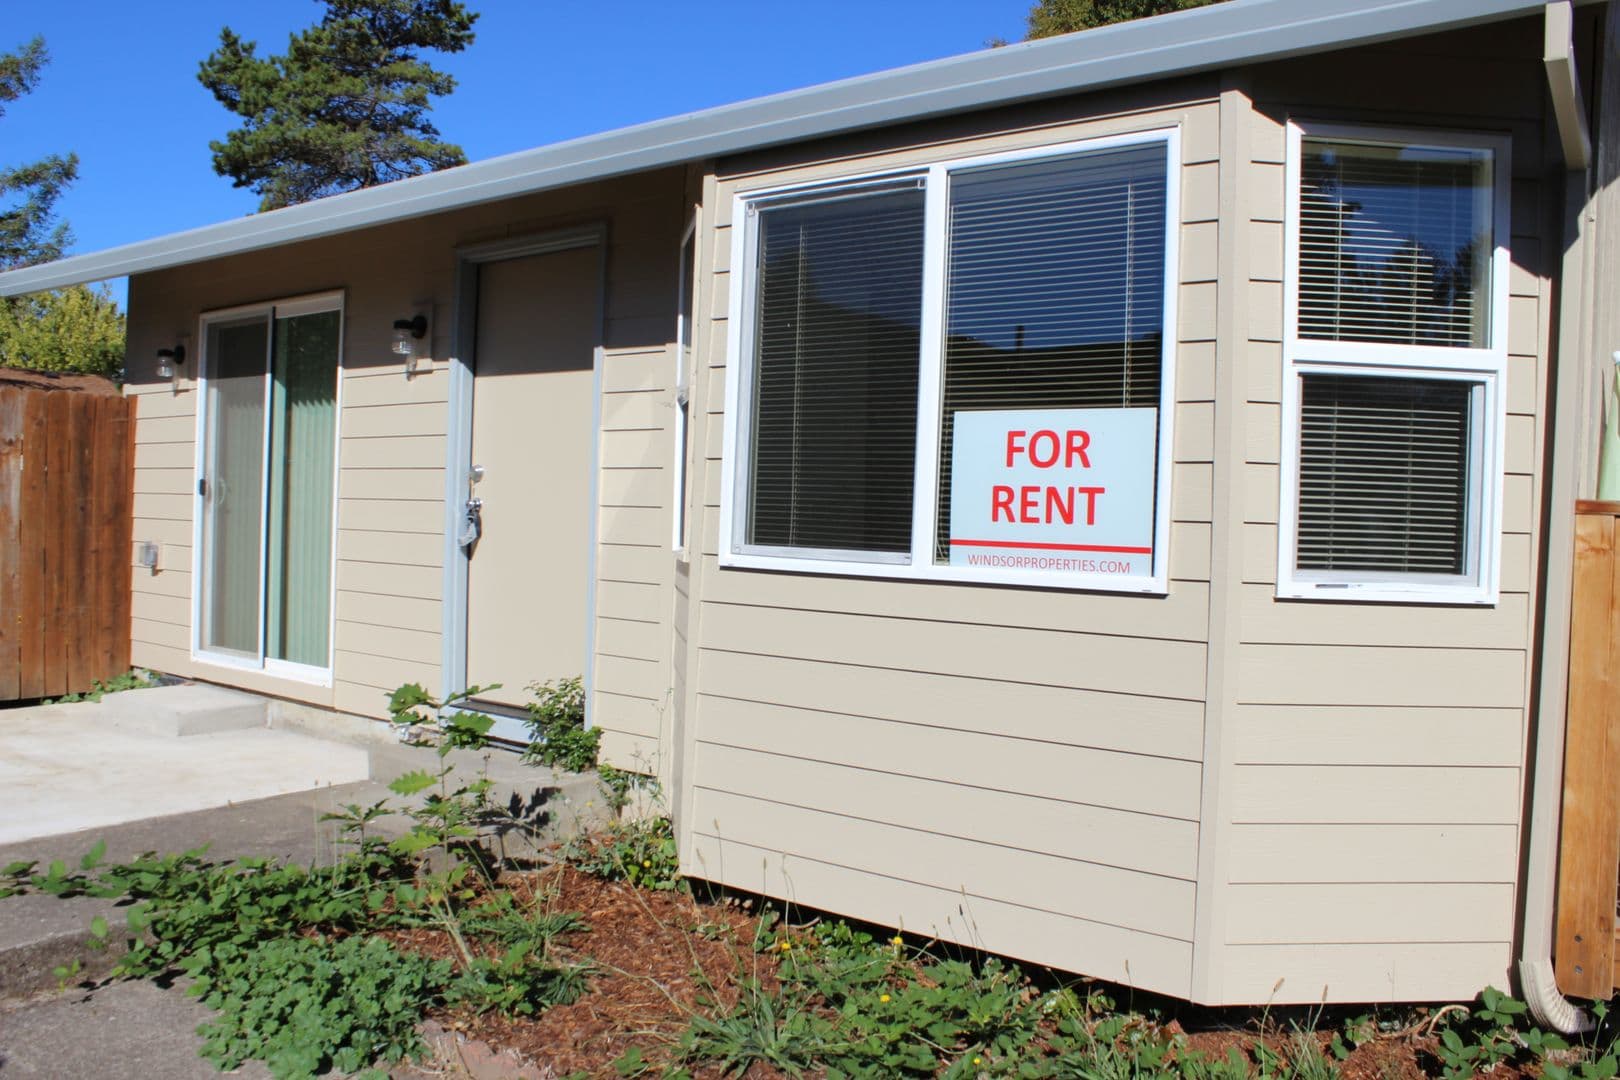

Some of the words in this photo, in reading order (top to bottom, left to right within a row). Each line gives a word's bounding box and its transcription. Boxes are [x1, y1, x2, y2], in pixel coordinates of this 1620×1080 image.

[1005, 429, 1091, 469] FOR
[991, 485, 1106, 526] RENT
[967, 554, 1131, 573] WINDSORPROPERTIES.COM
